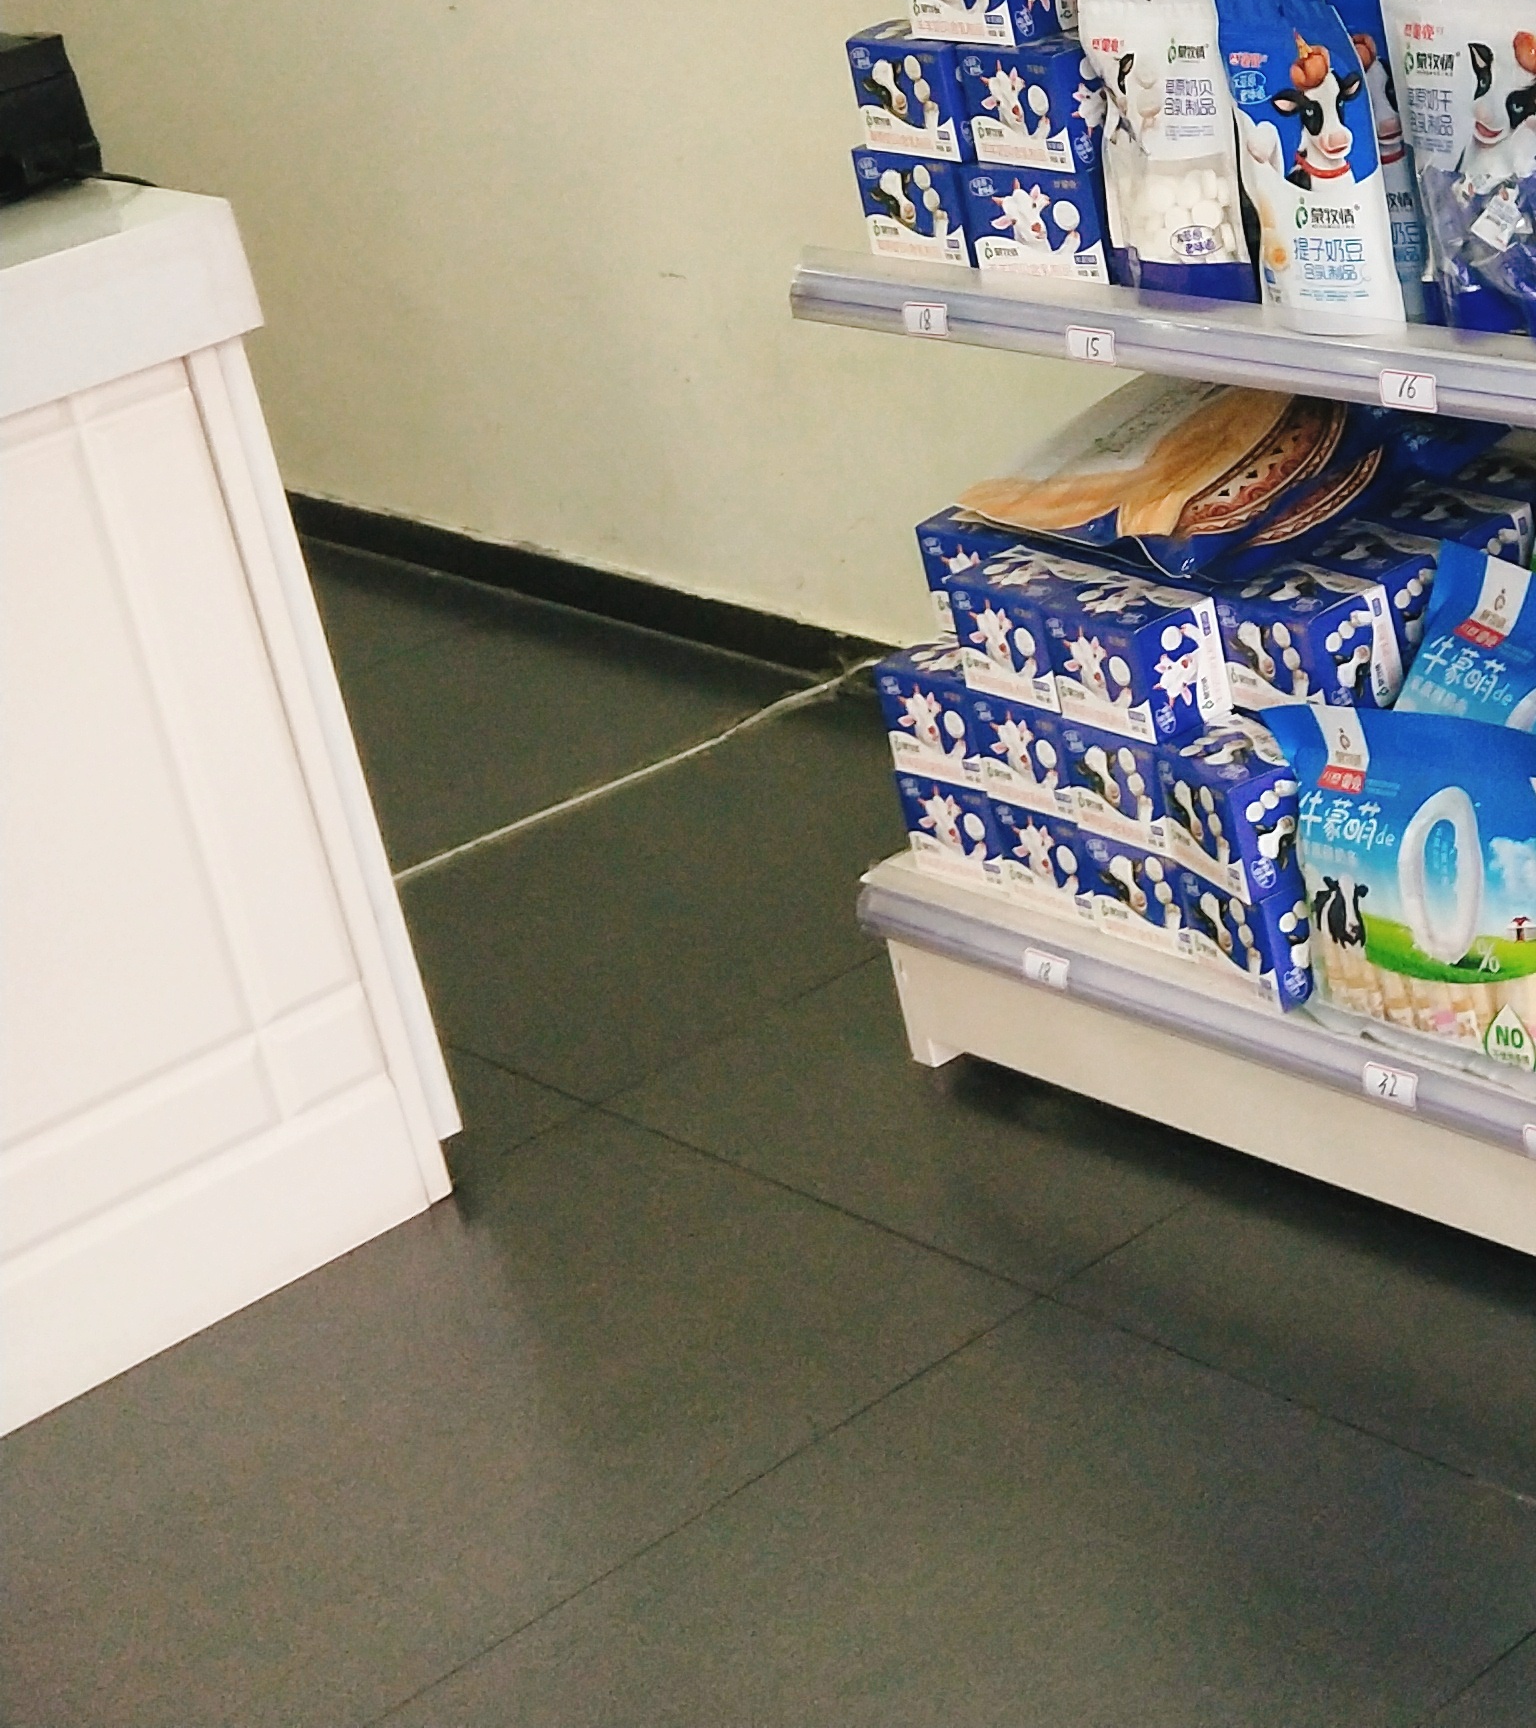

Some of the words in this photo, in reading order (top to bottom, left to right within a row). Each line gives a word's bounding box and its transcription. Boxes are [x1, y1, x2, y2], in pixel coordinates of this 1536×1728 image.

[1416, 52, 1455, 72] 蒙牧情
[1309, 206, 1356, 226] 蒙牧情
[1292, 237, 1364, 266] 提子奶豆
[919, 308, 931, 331] 18
[1086, 336, 1100, 358] 15
[1398, 375, 1421, 399] 16
[1496, 1024, 1524, 1048] NO
